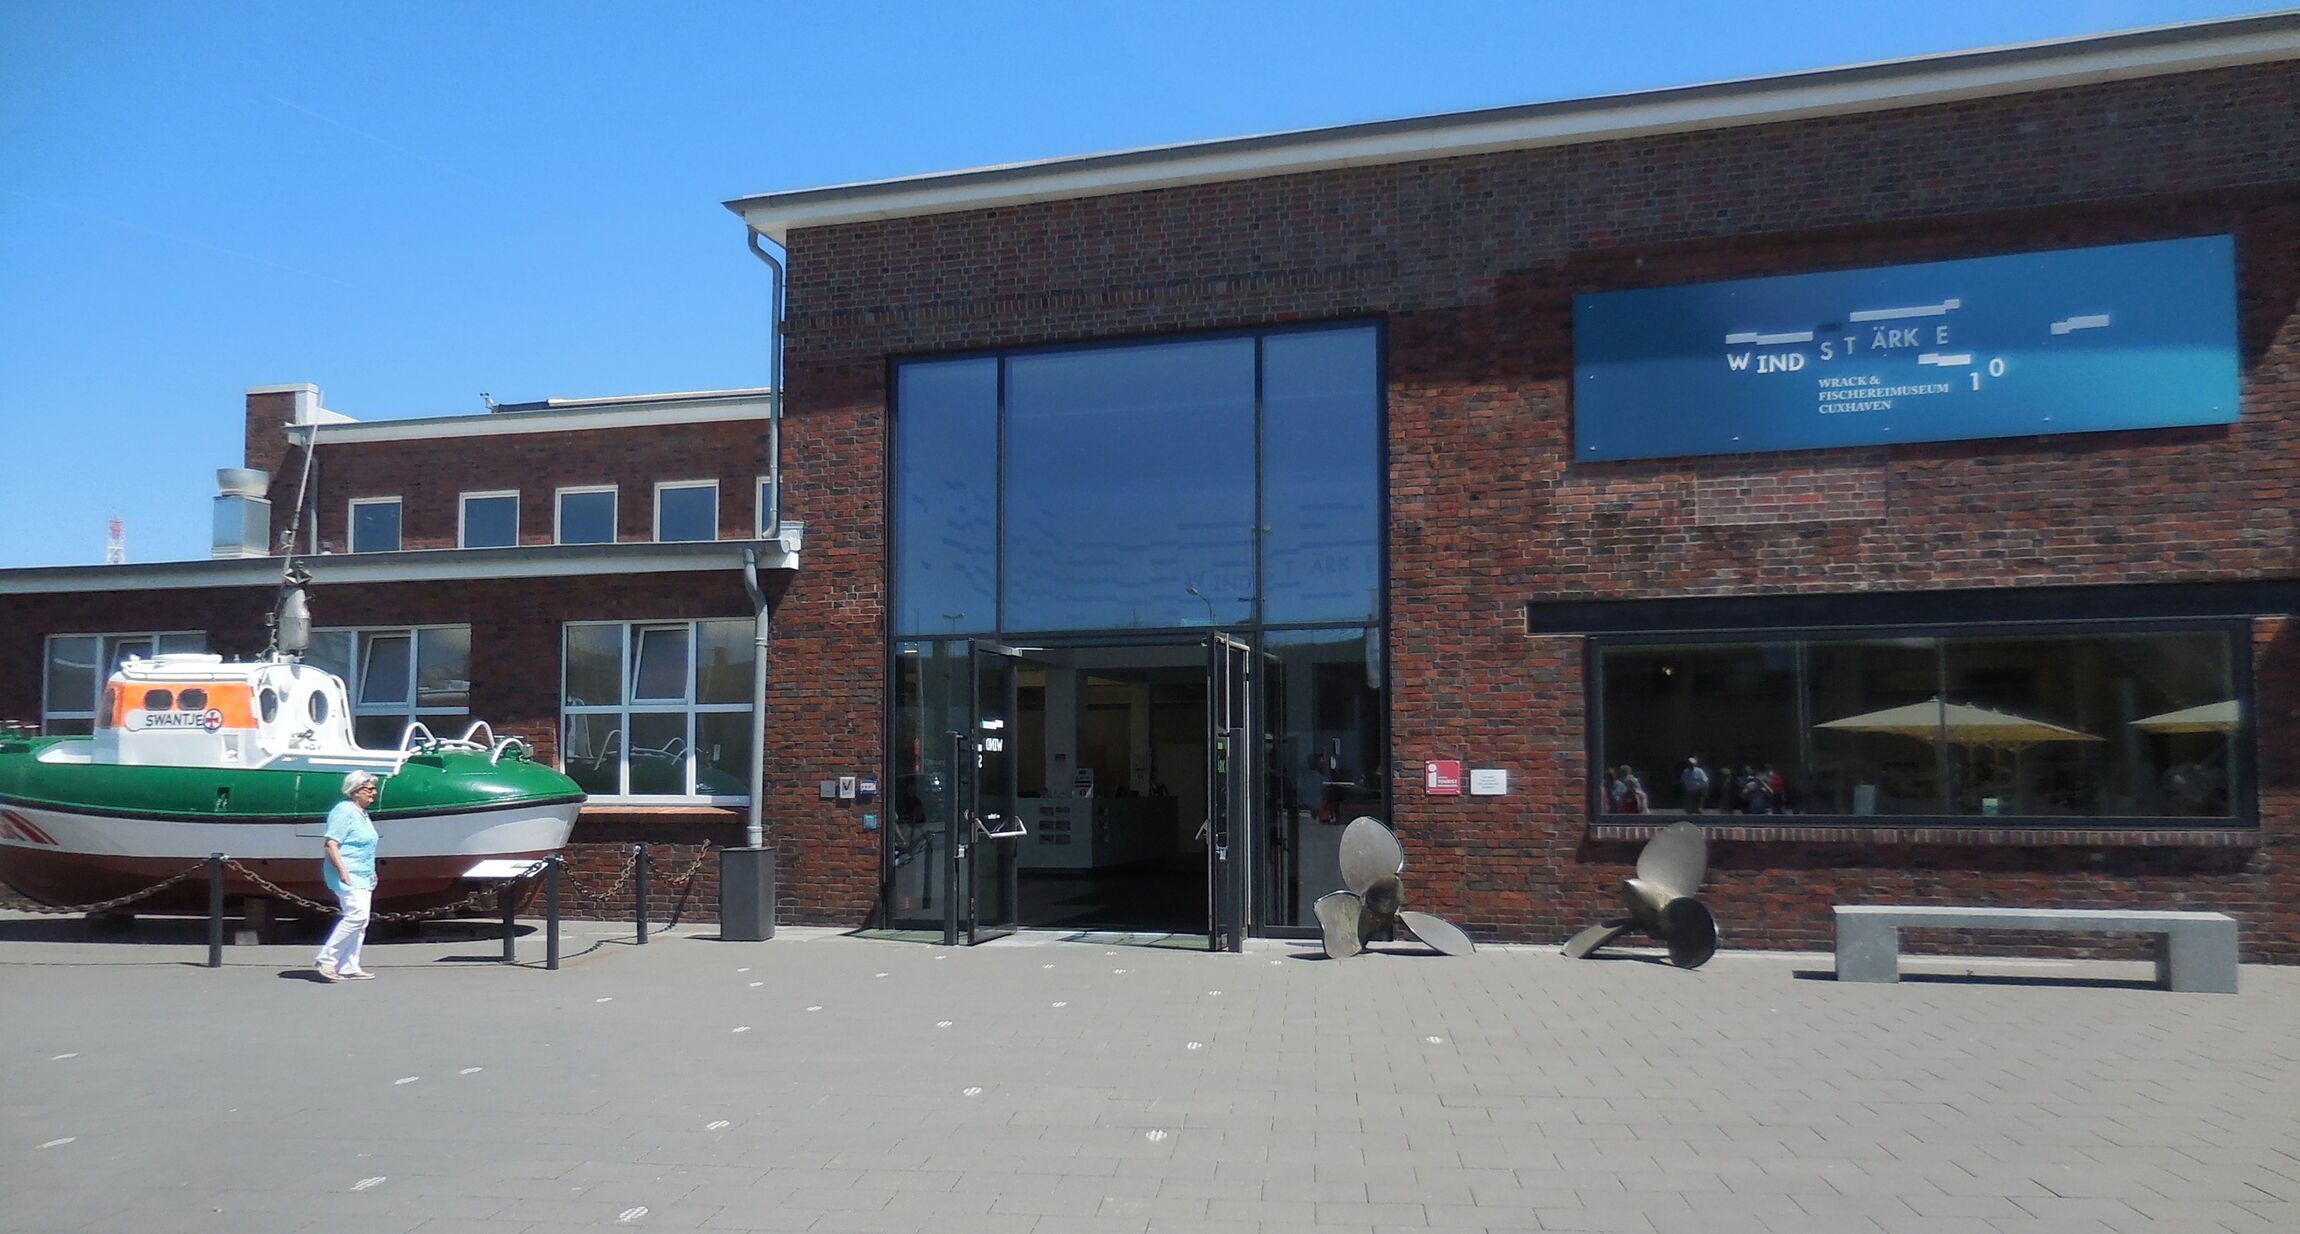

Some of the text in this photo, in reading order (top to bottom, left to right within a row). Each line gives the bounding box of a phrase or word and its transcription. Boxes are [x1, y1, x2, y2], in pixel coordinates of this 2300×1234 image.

[1818, 375, 1881, 388] WRACK &
[1818, 383, 1949, 401] FISCHEREIMUSEUM
[1818, 400, 1891, 415] CUXHAVEN
[145, 713, 205, 727] SWANTJE
